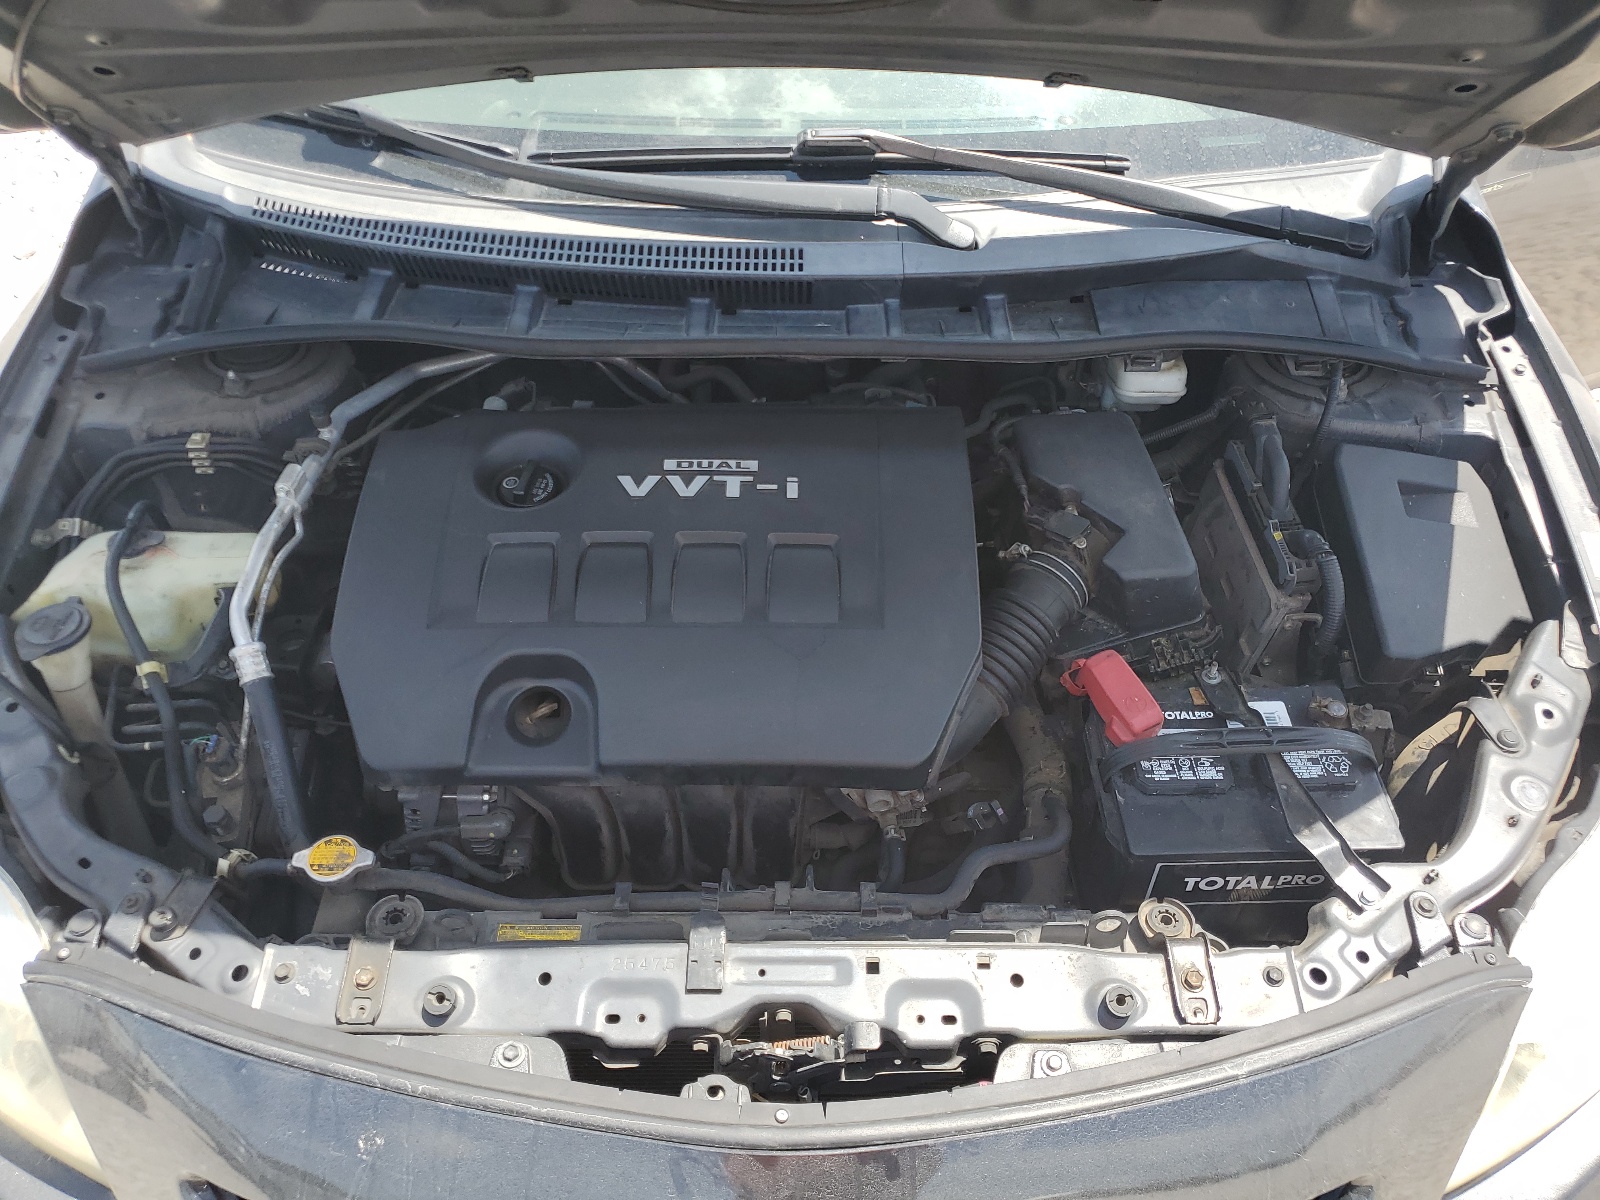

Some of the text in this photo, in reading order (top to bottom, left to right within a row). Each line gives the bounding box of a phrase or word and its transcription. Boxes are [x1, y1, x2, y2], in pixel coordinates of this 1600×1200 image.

[676, 461, 750, 469] DUAL
[616, 475, 798, 499] VVT-i
[1163, 711, 1214, 720] OTALPRO
